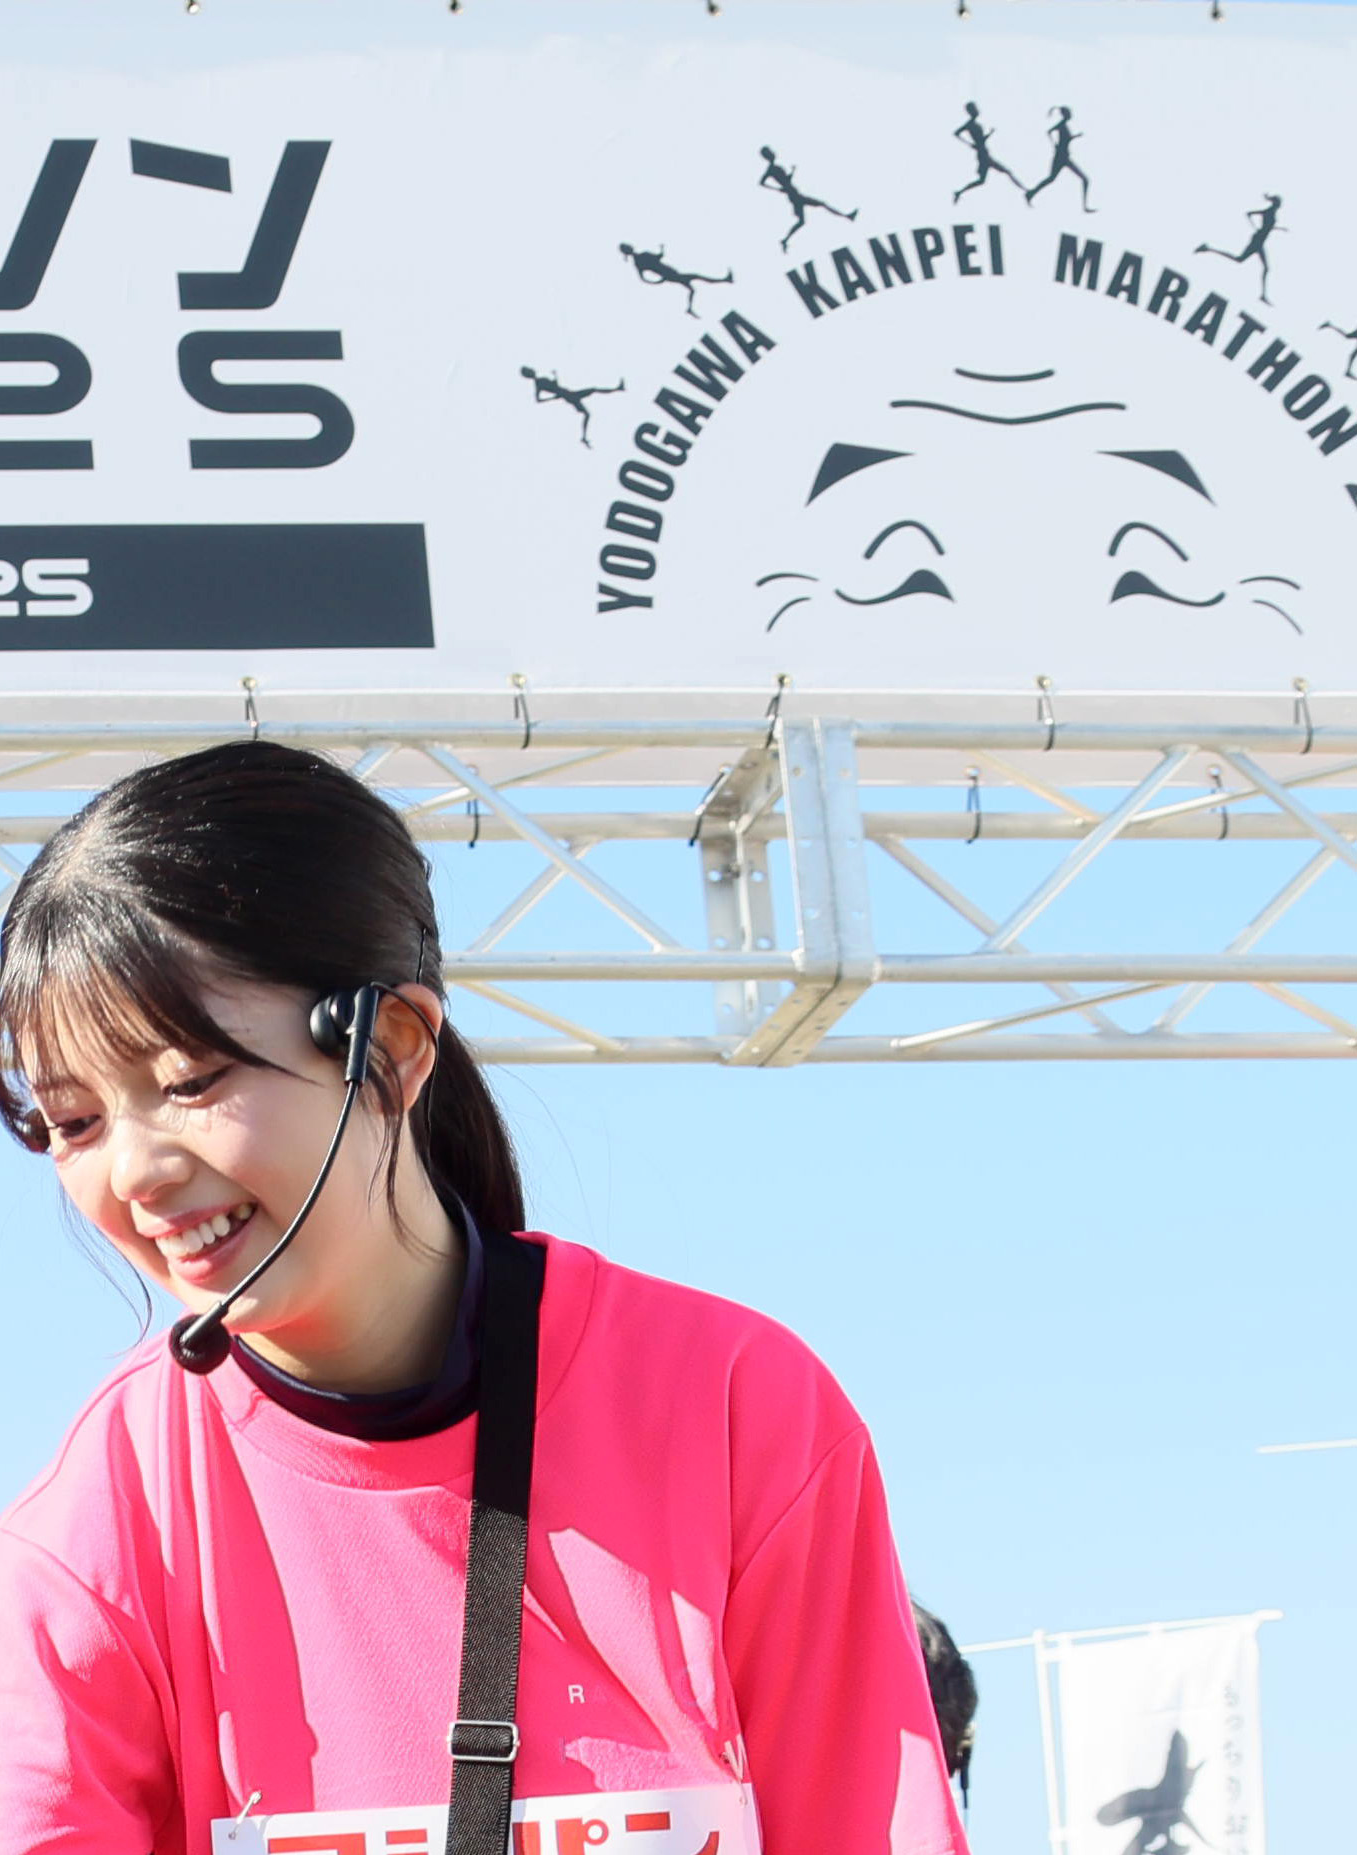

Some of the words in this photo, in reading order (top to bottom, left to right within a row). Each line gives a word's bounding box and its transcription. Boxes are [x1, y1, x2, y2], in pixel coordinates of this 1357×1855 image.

[596, 309, 777, 613] YODOGAWA
[785, 223, 1006, 320] KANPEI
[1054, 232, 1357, 457] MARATHON
[567, 1684, 586, 1704] R
